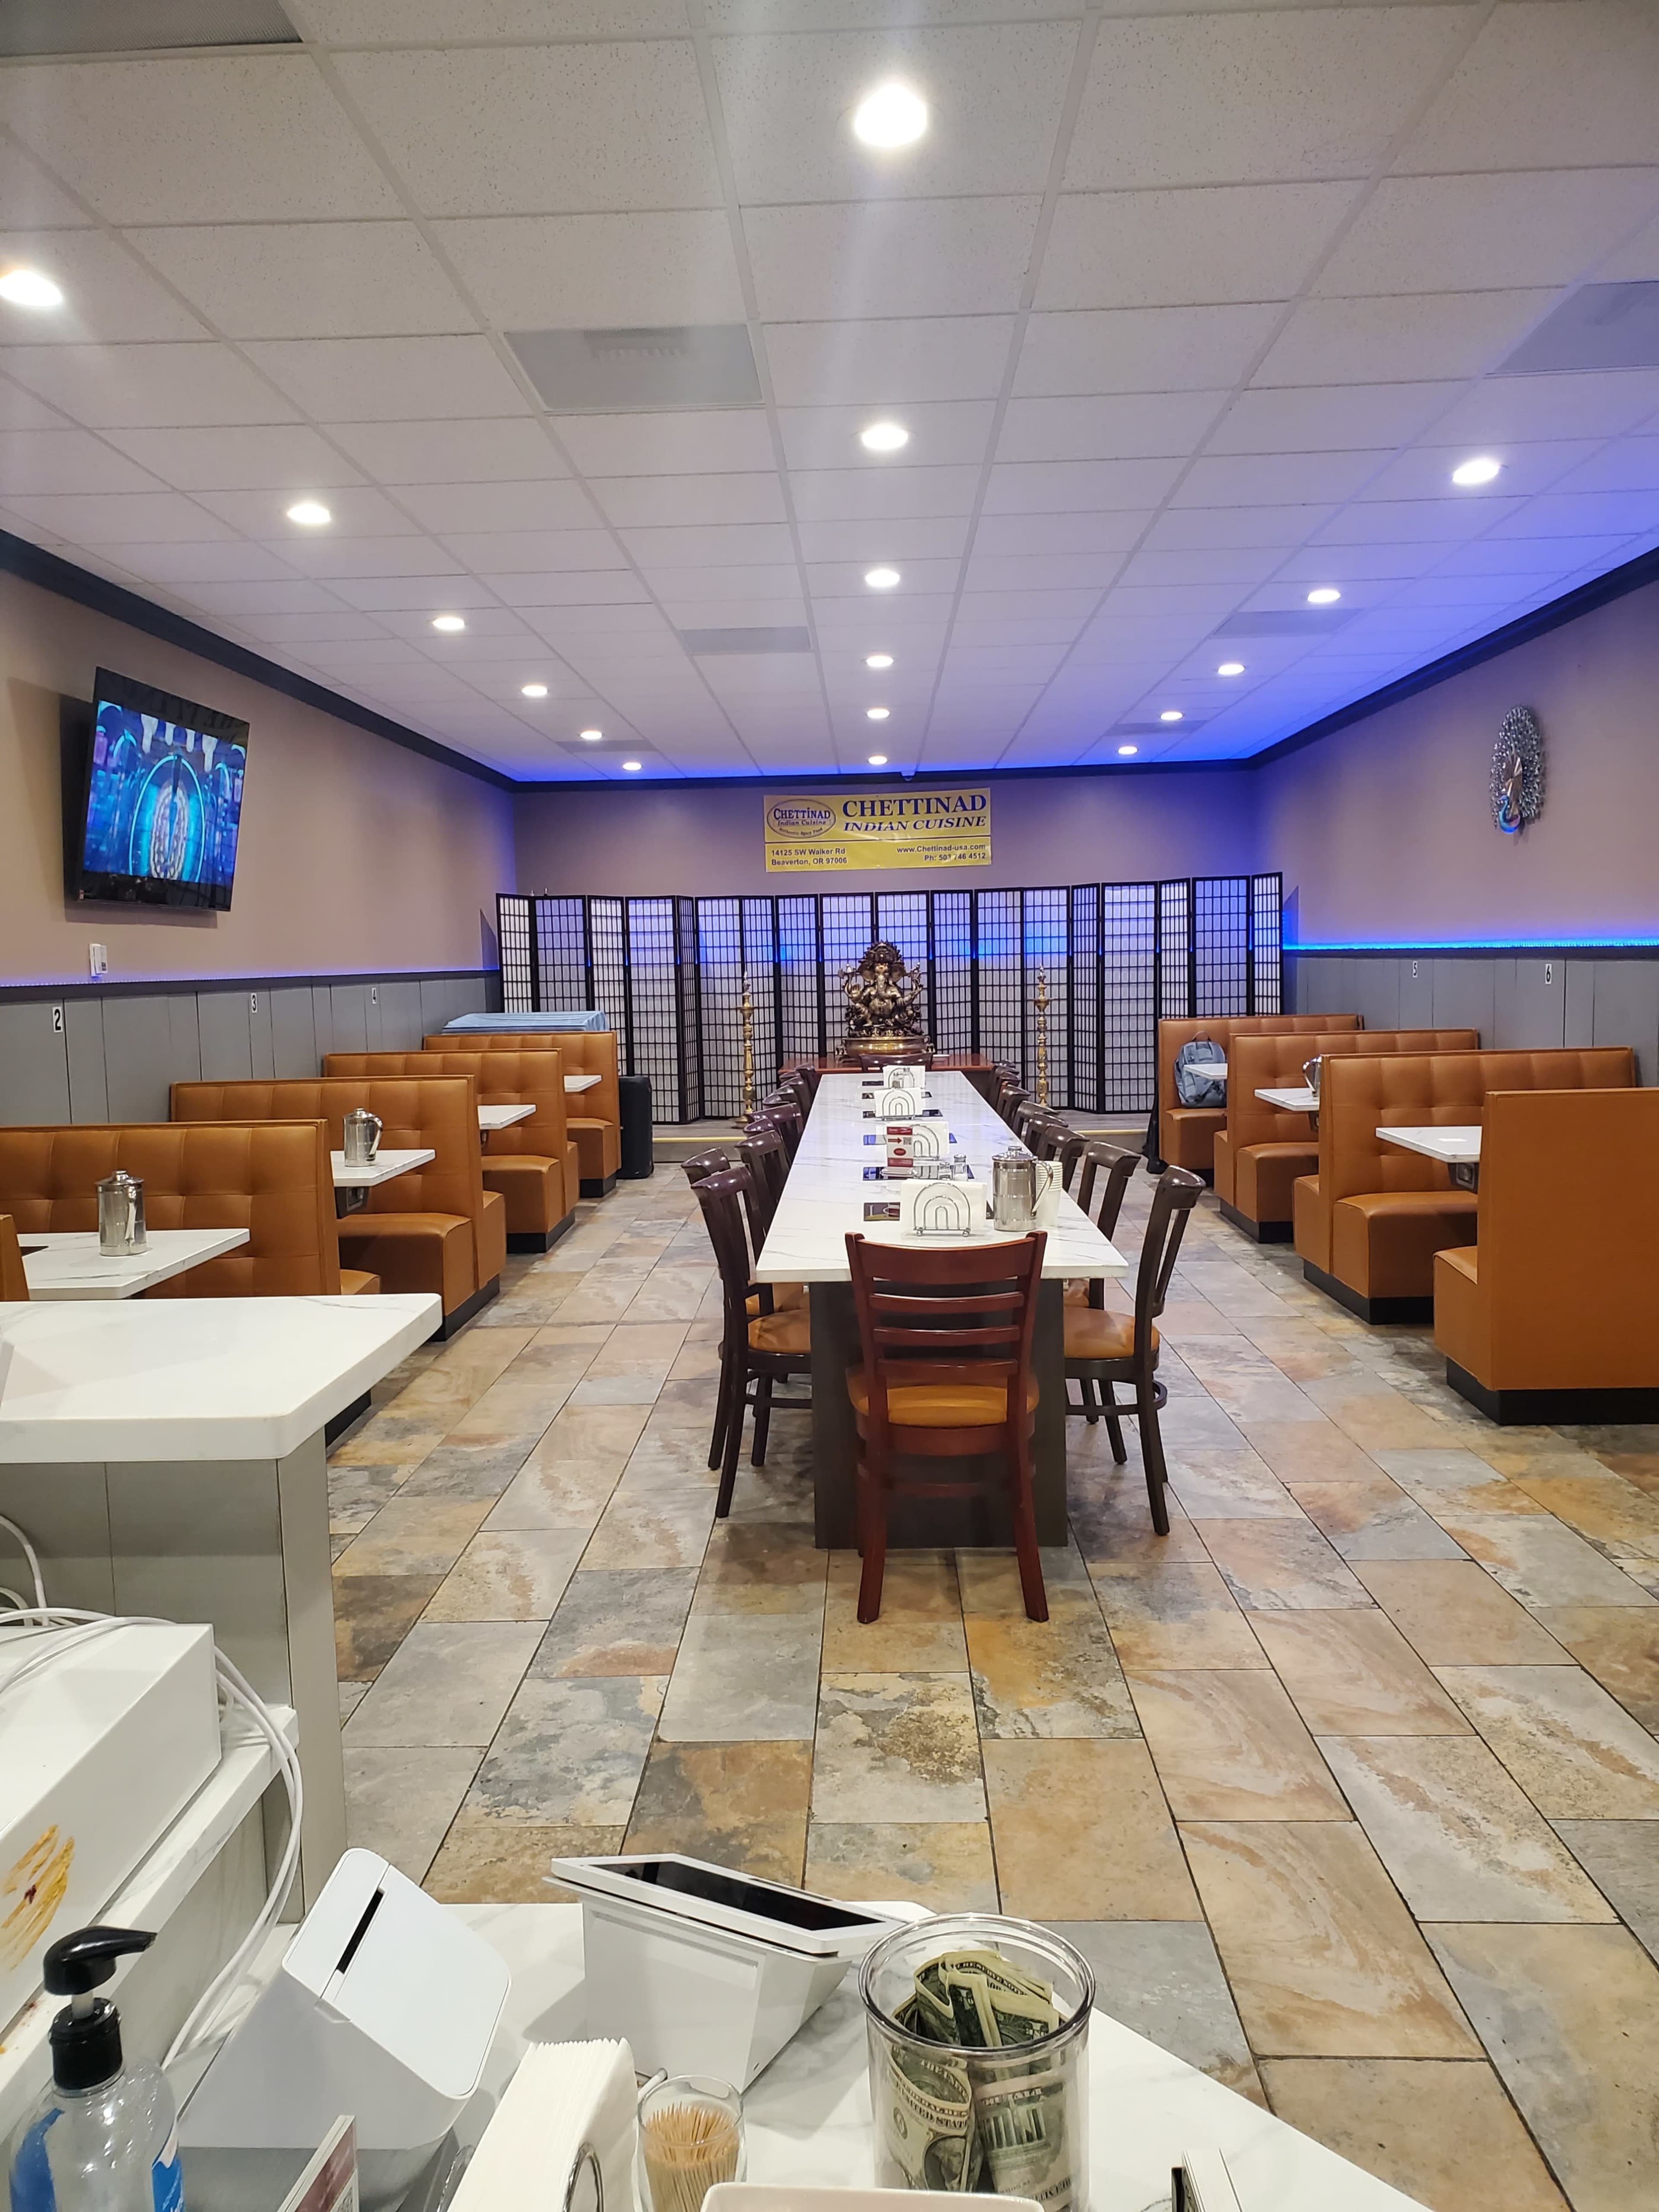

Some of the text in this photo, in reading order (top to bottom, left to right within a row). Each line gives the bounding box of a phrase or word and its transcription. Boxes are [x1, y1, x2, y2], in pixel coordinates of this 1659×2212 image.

[843, 795, 986, 817] CHETTINAD
[844, 816, 986, 831] INDIAN CUISINE
[896, 844, 985, 853] www.Chettinad-usa.com
[1546, 965, 1551, 982] 6
[251, 995, 257, 1011] 3
[54, 1009, 61, 1031] 2
